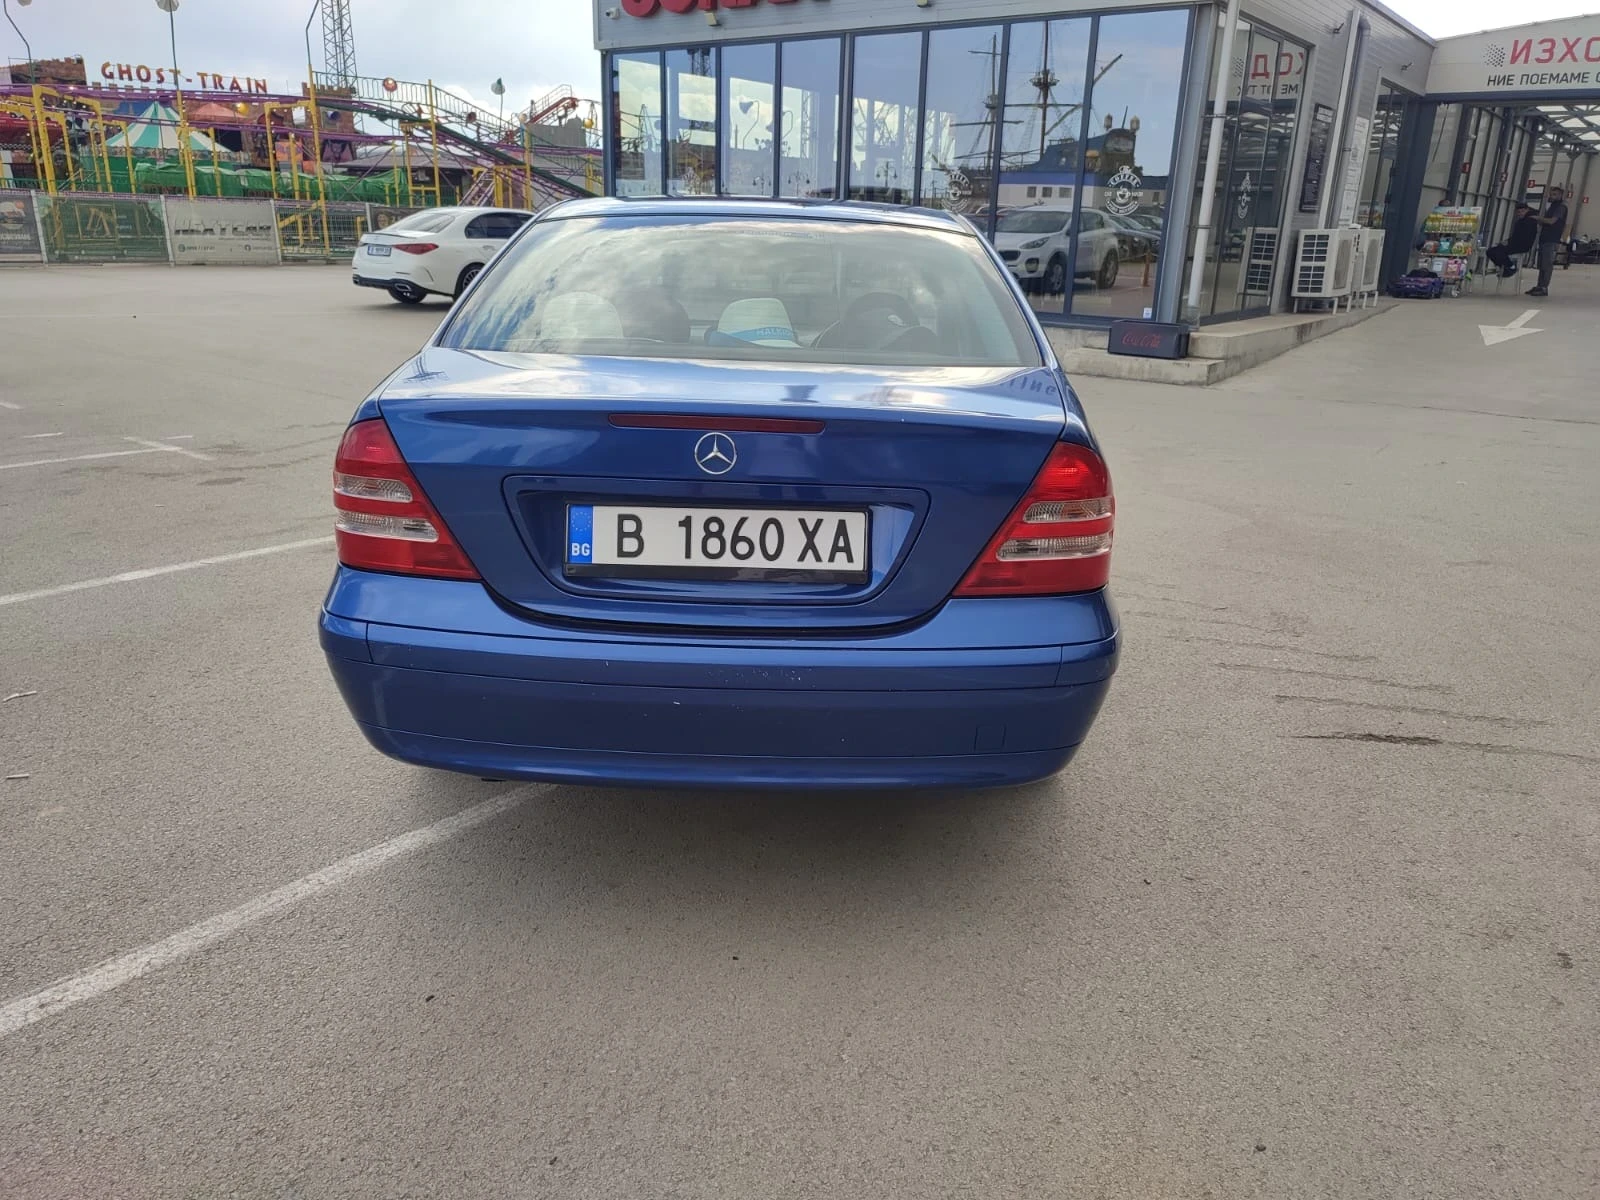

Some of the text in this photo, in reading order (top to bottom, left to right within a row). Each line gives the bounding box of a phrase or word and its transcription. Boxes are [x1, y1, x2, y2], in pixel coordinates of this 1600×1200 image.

[101, 61, 268, 94] GHOST-TRAIN
[1487, 74, 1515, 86] НИЕ
[1520, 72, 1590, 85] ПОЕМАМЕ
[571, 542, 590, 557] BG
[616, 513, 854, 563] B 1860 XA
